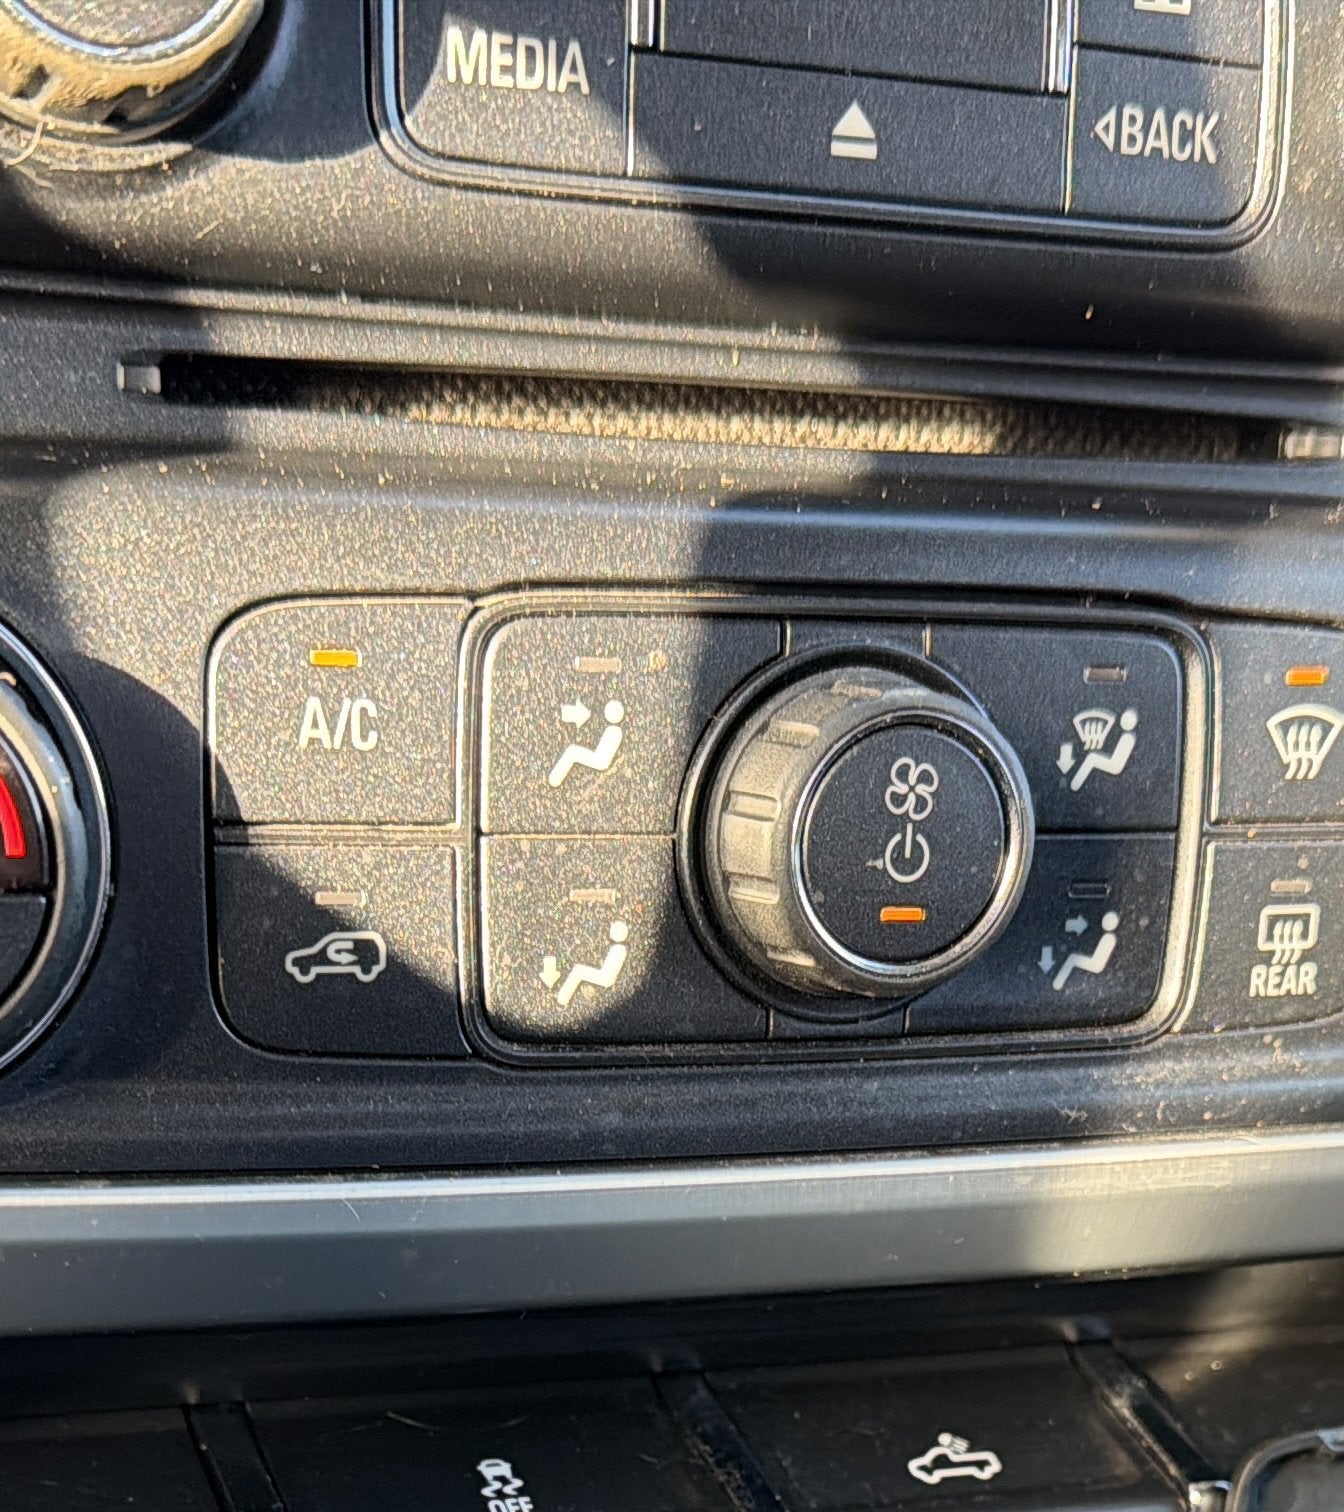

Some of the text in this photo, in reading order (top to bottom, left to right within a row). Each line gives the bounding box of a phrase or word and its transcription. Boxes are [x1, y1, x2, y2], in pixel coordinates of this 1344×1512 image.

[444, 27, 590, 97] MEDIA
[1120, 107, 1218, 164] BACK
[299, 697, 379, 752] A/C
[1249, 962, 1318, 997] REAR
